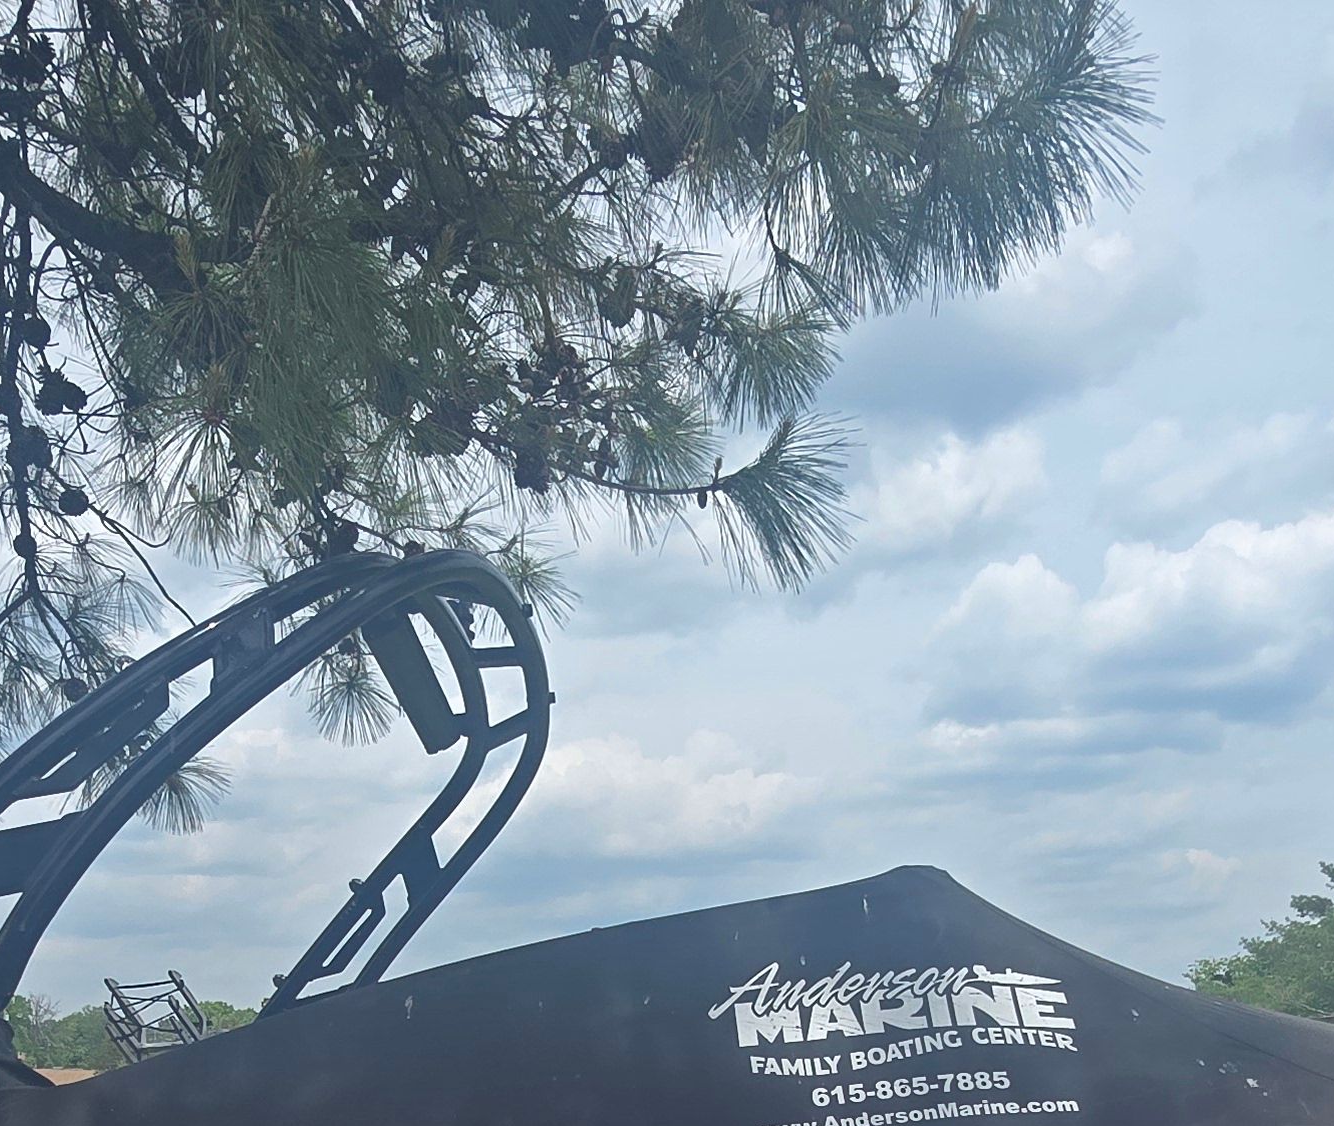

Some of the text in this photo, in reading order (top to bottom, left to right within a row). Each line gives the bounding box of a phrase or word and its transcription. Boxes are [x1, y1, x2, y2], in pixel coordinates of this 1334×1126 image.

[708, 961, 973, 1020] Anderson
[734, 986, 1077, 1048] MARINE
[750, 1026, 1079, 1077] FAMILY BOATING CENTER
[811, 1071, 1011, 1108] 615-865-7885
